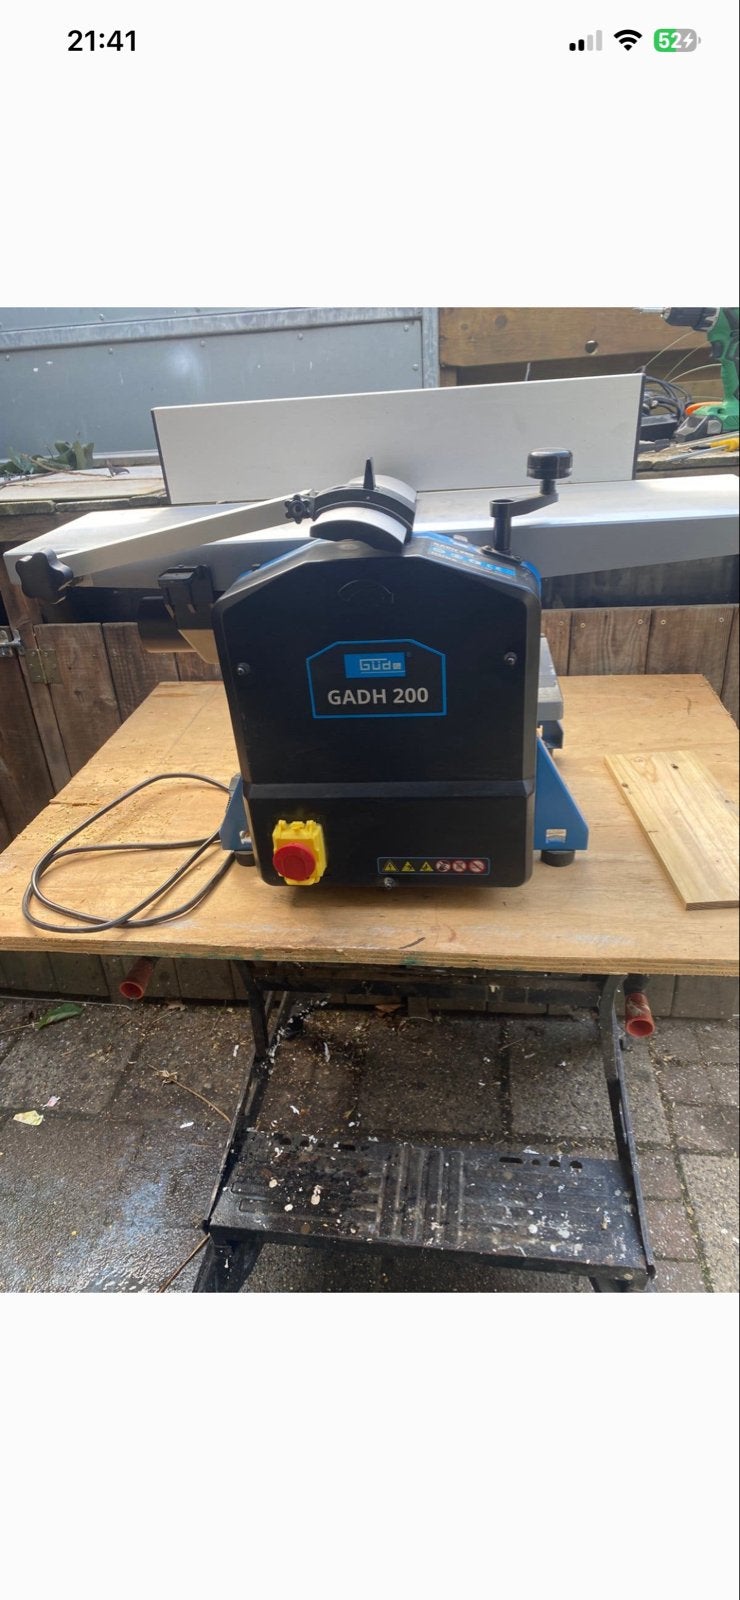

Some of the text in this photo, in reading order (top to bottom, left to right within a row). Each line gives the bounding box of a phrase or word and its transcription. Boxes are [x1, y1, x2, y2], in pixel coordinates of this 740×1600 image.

[359, 658, 402, 671] Güde
[327, 687, 429, 705] GADH 200
